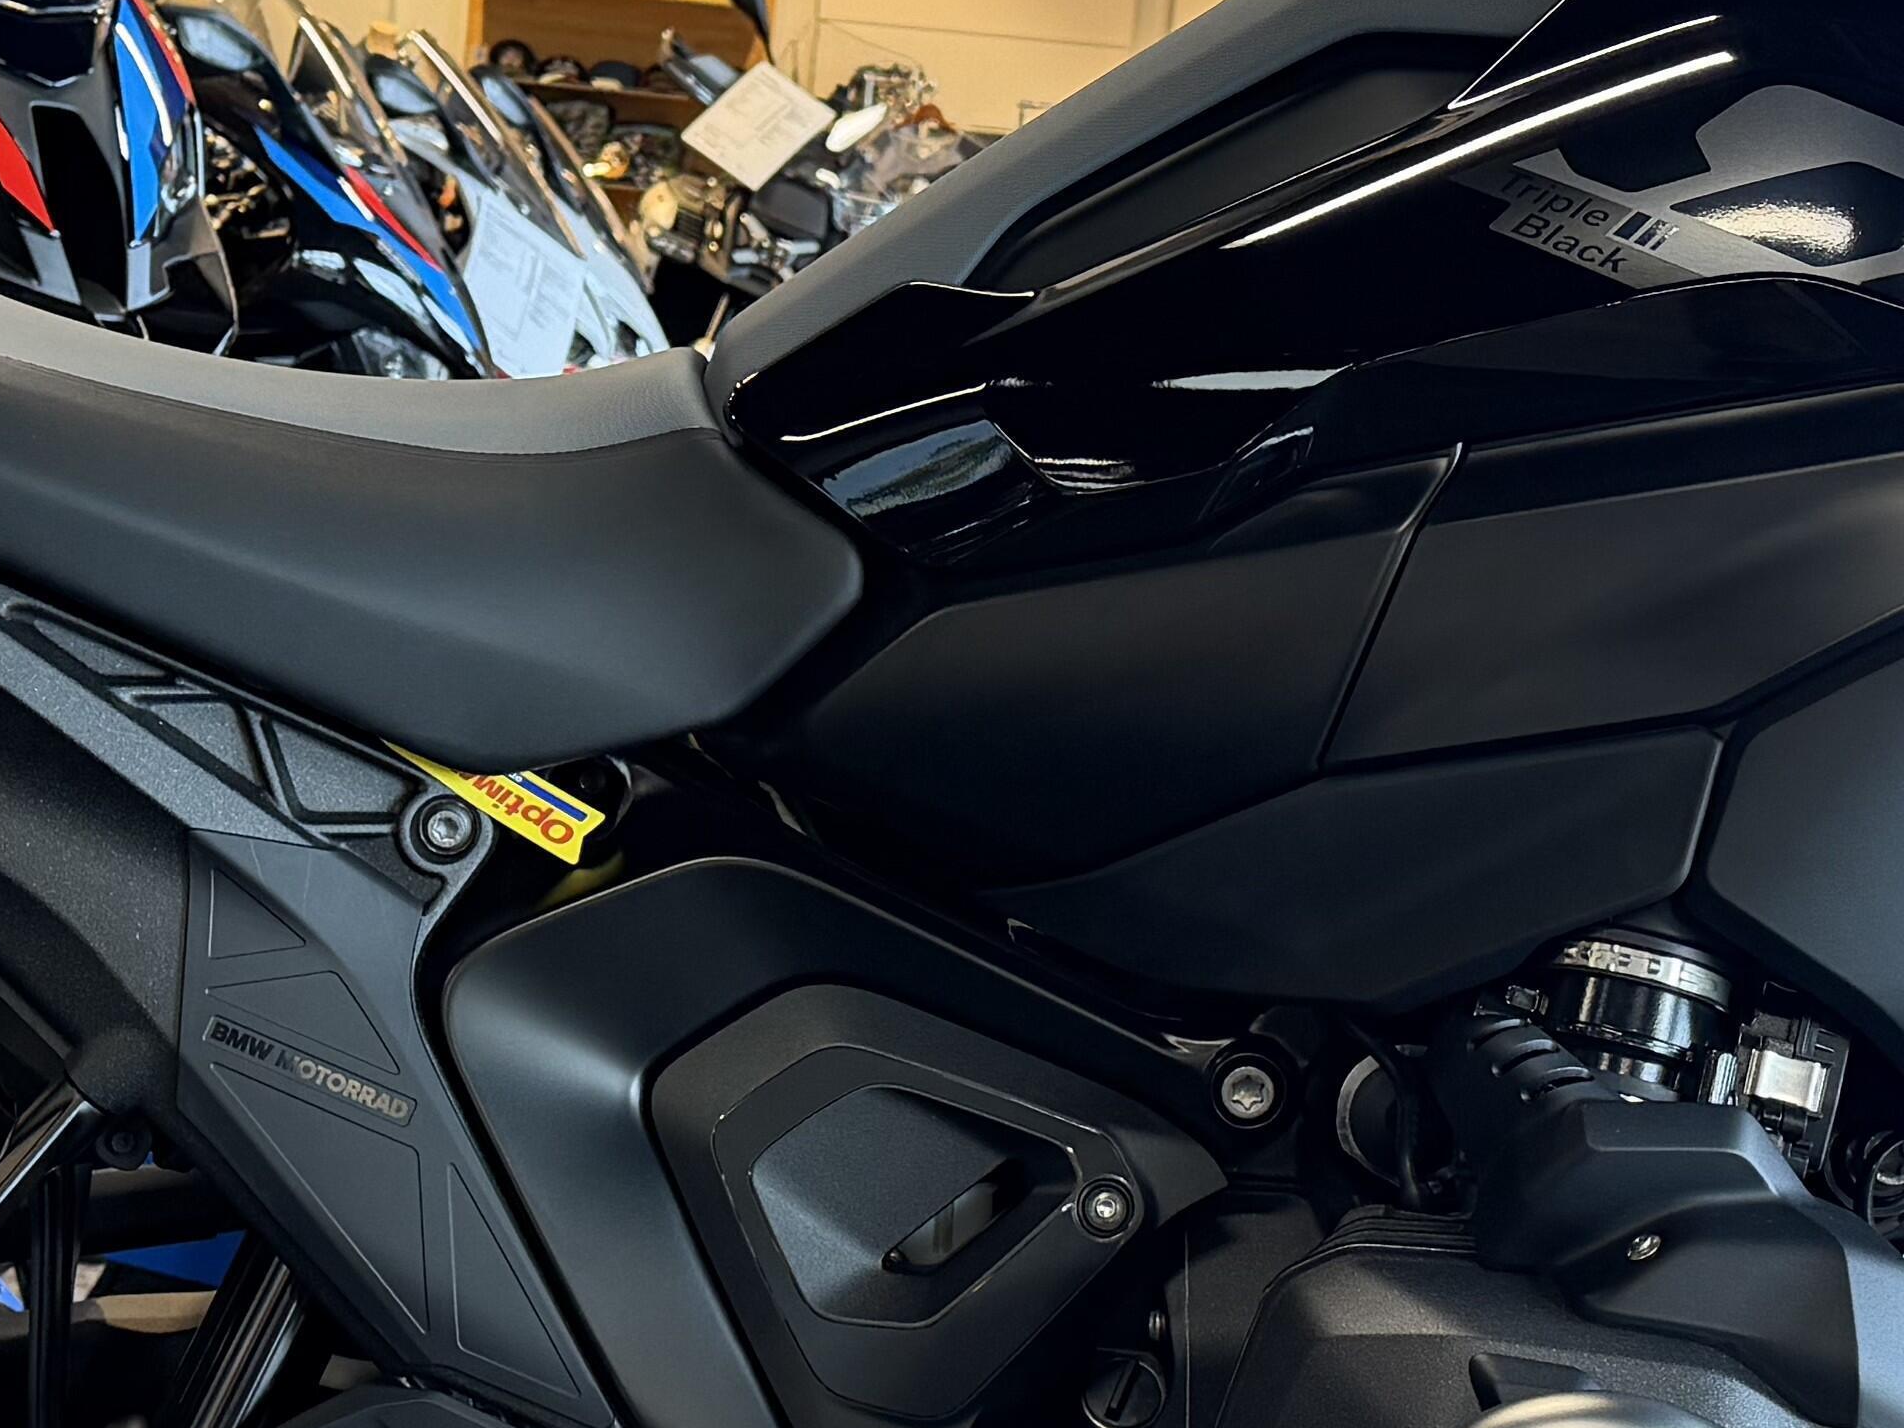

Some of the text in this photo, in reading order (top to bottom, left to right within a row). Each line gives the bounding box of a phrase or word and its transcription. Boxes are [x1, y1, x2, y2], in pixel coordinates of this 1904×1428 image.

[1499, 174, 1610, 227] Triple
[1510, 212, 1630, 274] Black
[210, 1022, 409, 1119] BMW MOTORRAD
